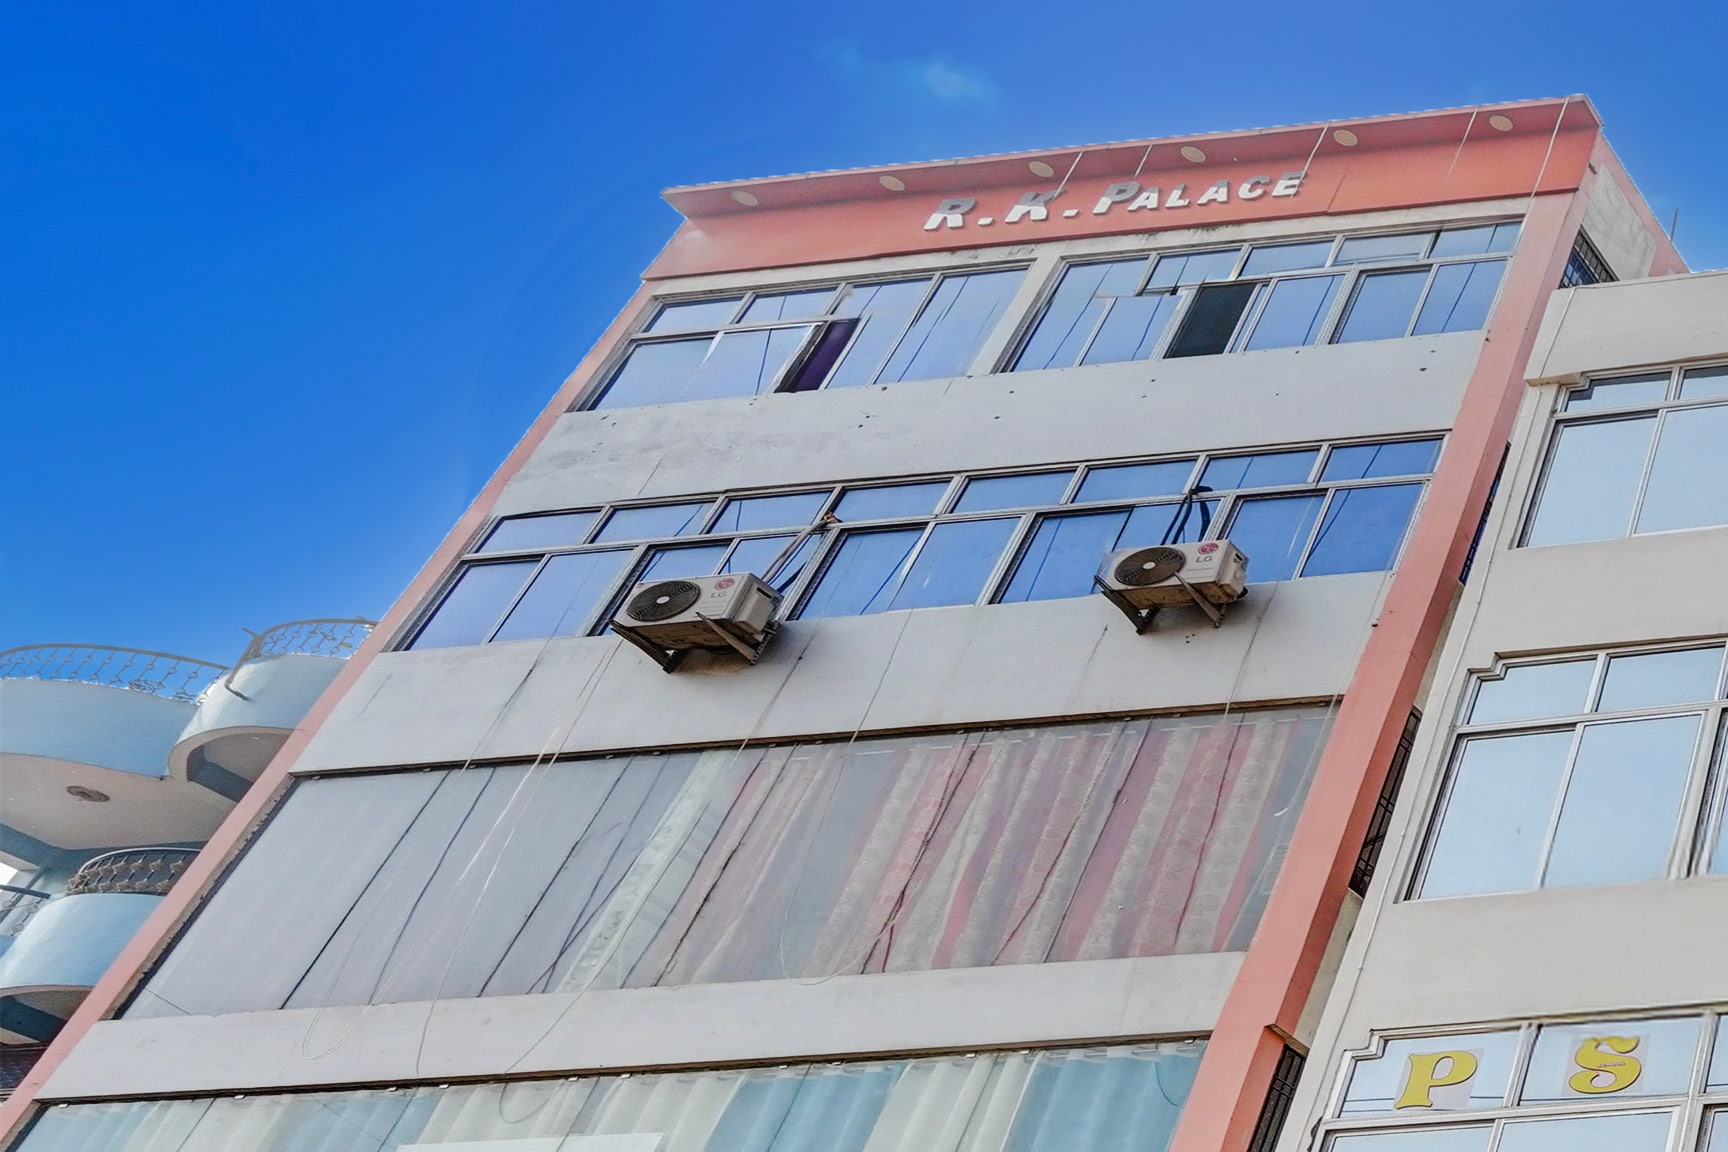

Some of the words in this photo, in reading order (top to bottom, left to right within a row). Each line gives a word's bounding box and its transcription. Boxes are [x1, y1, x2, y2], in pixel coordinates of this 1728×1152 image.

[1091, 171, 1311, 215] PALACE
[1195, 555, 1213, 563] LG
[711, 591, 727, 599] LG
